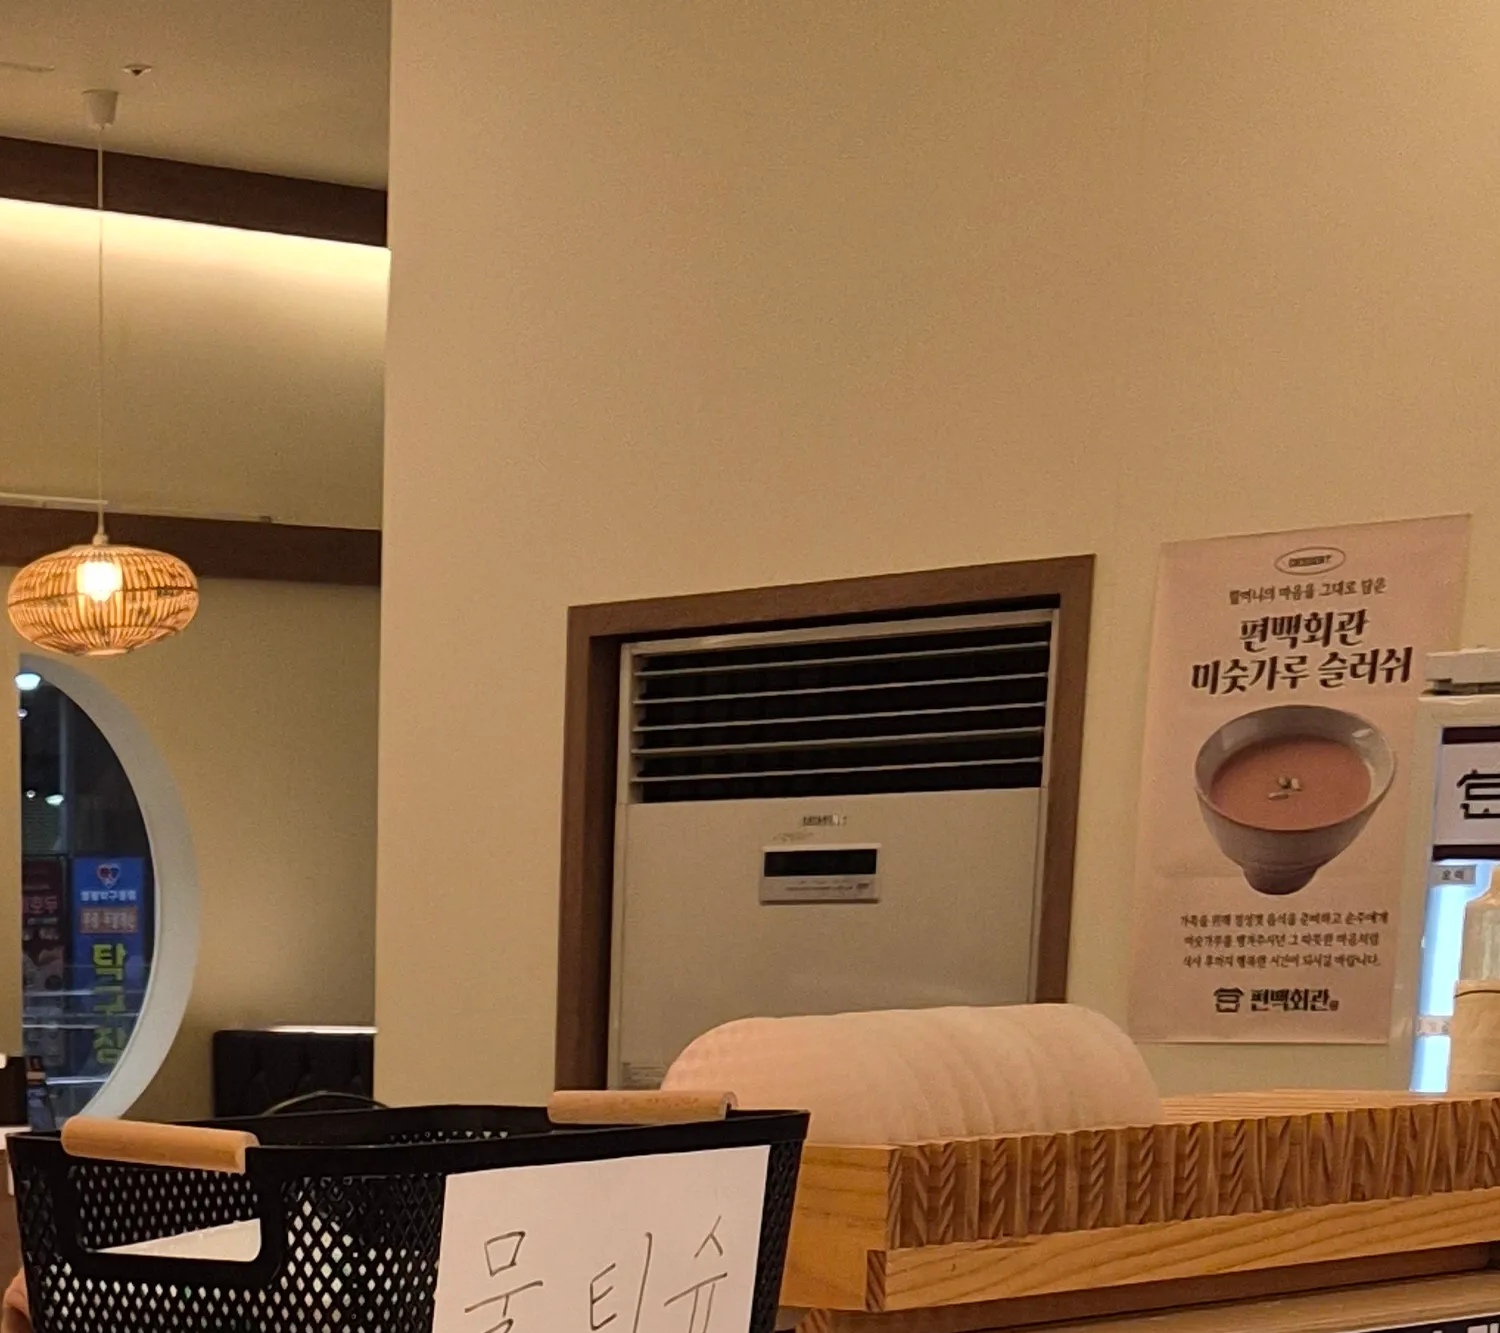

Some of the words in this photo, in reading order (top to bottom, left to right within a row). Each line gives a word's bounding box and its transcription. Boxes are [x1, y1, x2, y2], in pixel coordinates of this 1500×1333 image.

[1279, 583, 1314, 600] 마음을
[1319, 579, 1357, 597] 그대로
[1361, 577, 1387, 594] 담은
[1240, 609, 1370, 652] 편백회관
[1191, 655, 1310, 694] 미숫가루
[1318, 647, 1413, 688] 슬러쉬
[1288, 933, 1298, 946] 그
[1250, 988, 1330, 1011] 편백회관
